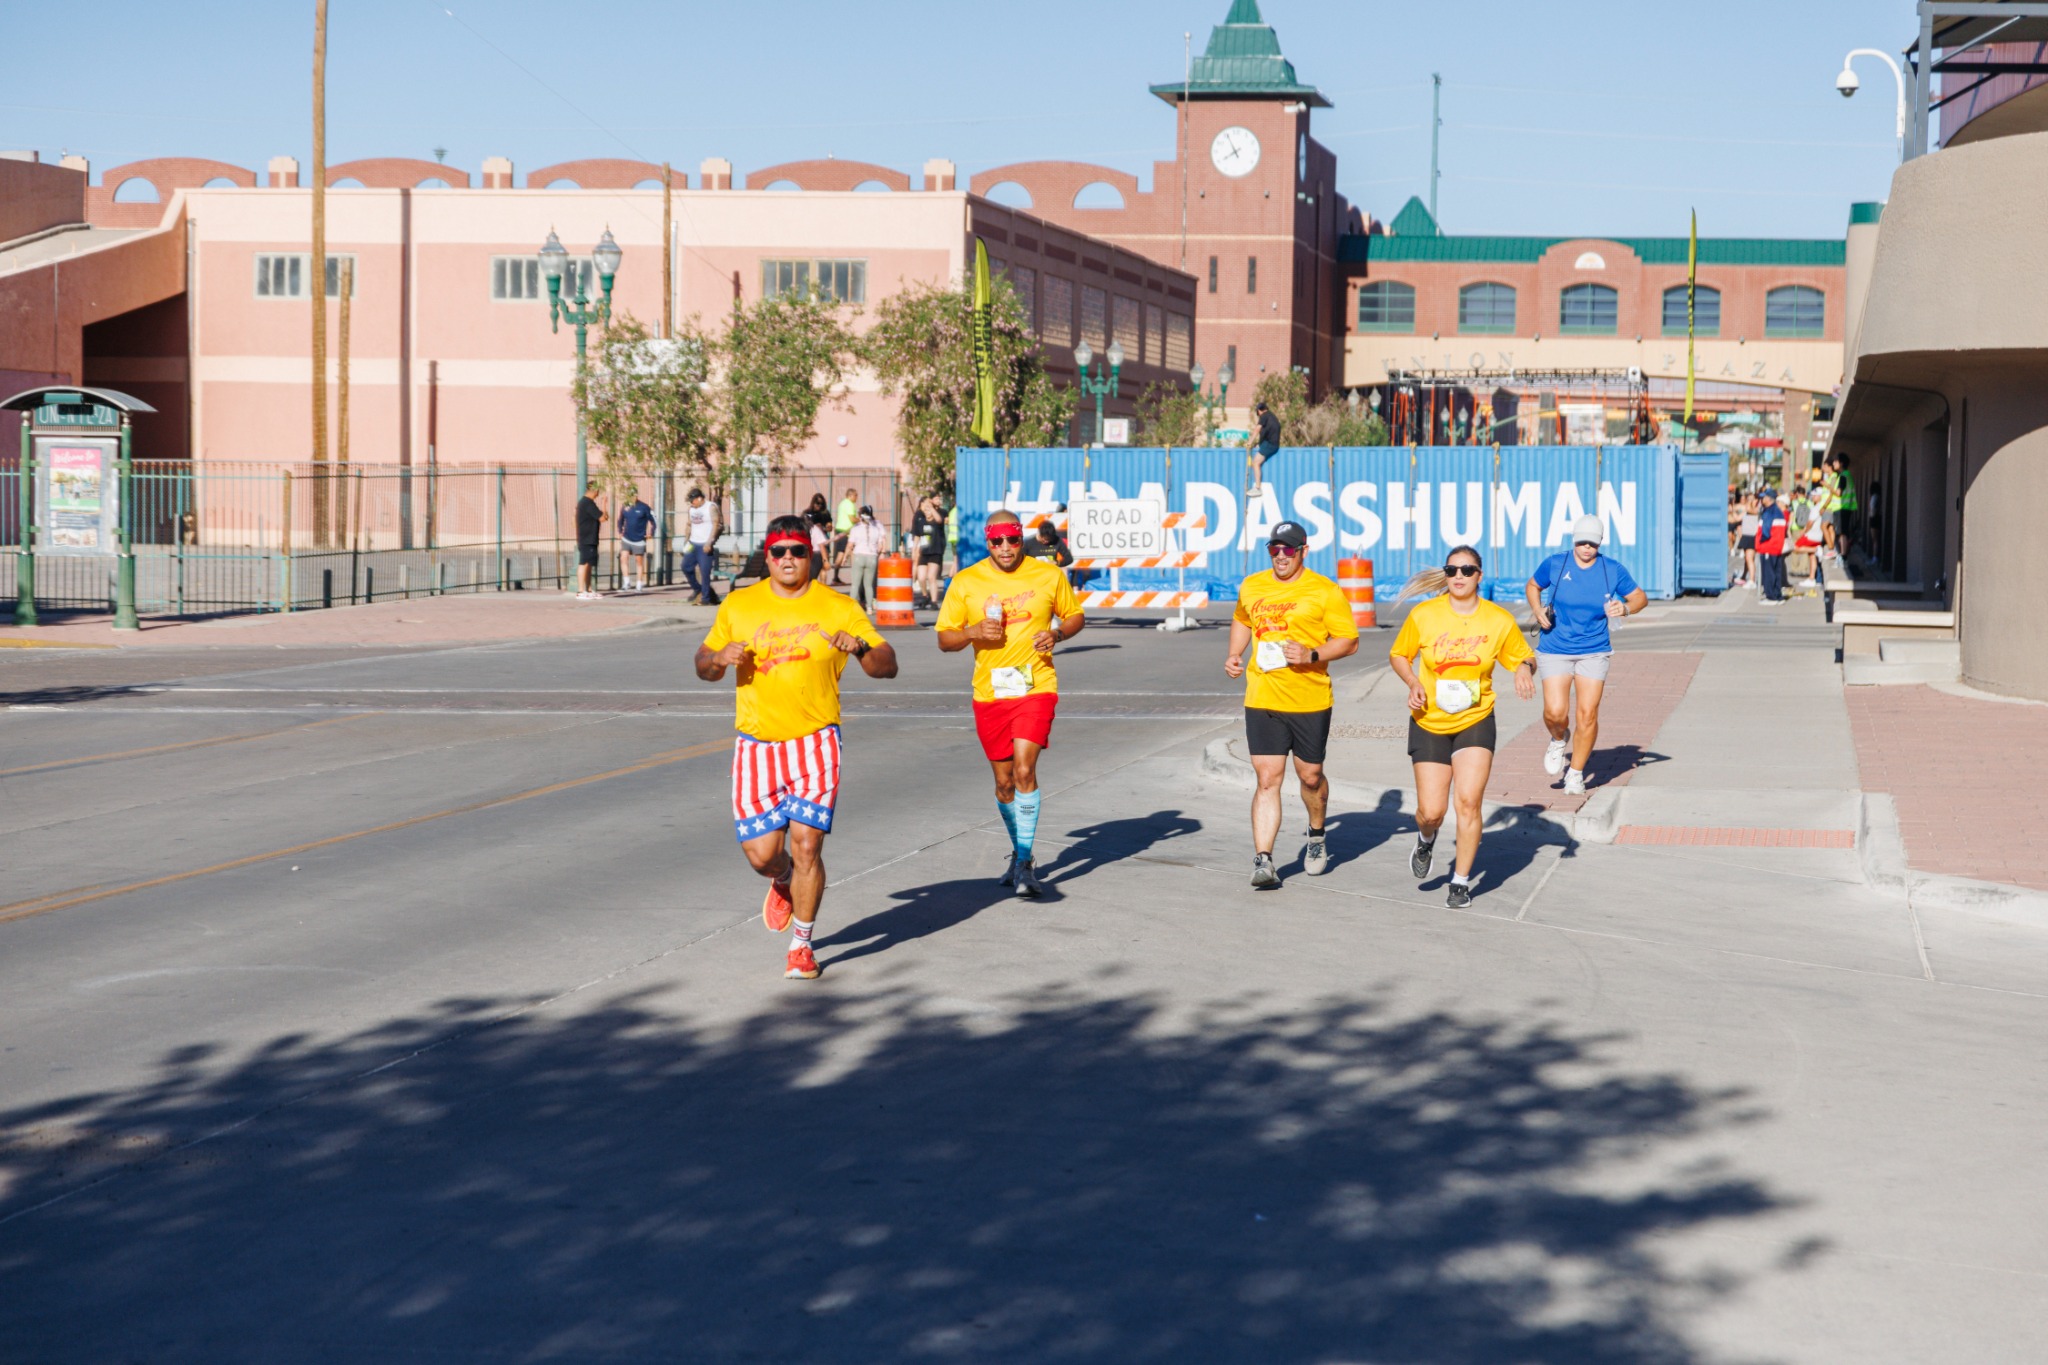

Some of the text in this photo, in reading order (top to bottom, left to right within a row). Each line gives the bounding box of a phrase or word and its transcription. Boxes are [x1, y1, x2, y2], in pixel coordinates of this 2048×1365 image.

[1381, 351, 1796, 383] UNION PLAZA
[987, 479, 1637, 552] #DASSHUMAN
[1087, 508, 1142, 525] ROAD
[1076, 531, 1154, 549] CLOSED
[1251, 597, 1297, 619] Average
[752, 620, 820, 648] Average
[1432, 632, 1489, 654] Average
